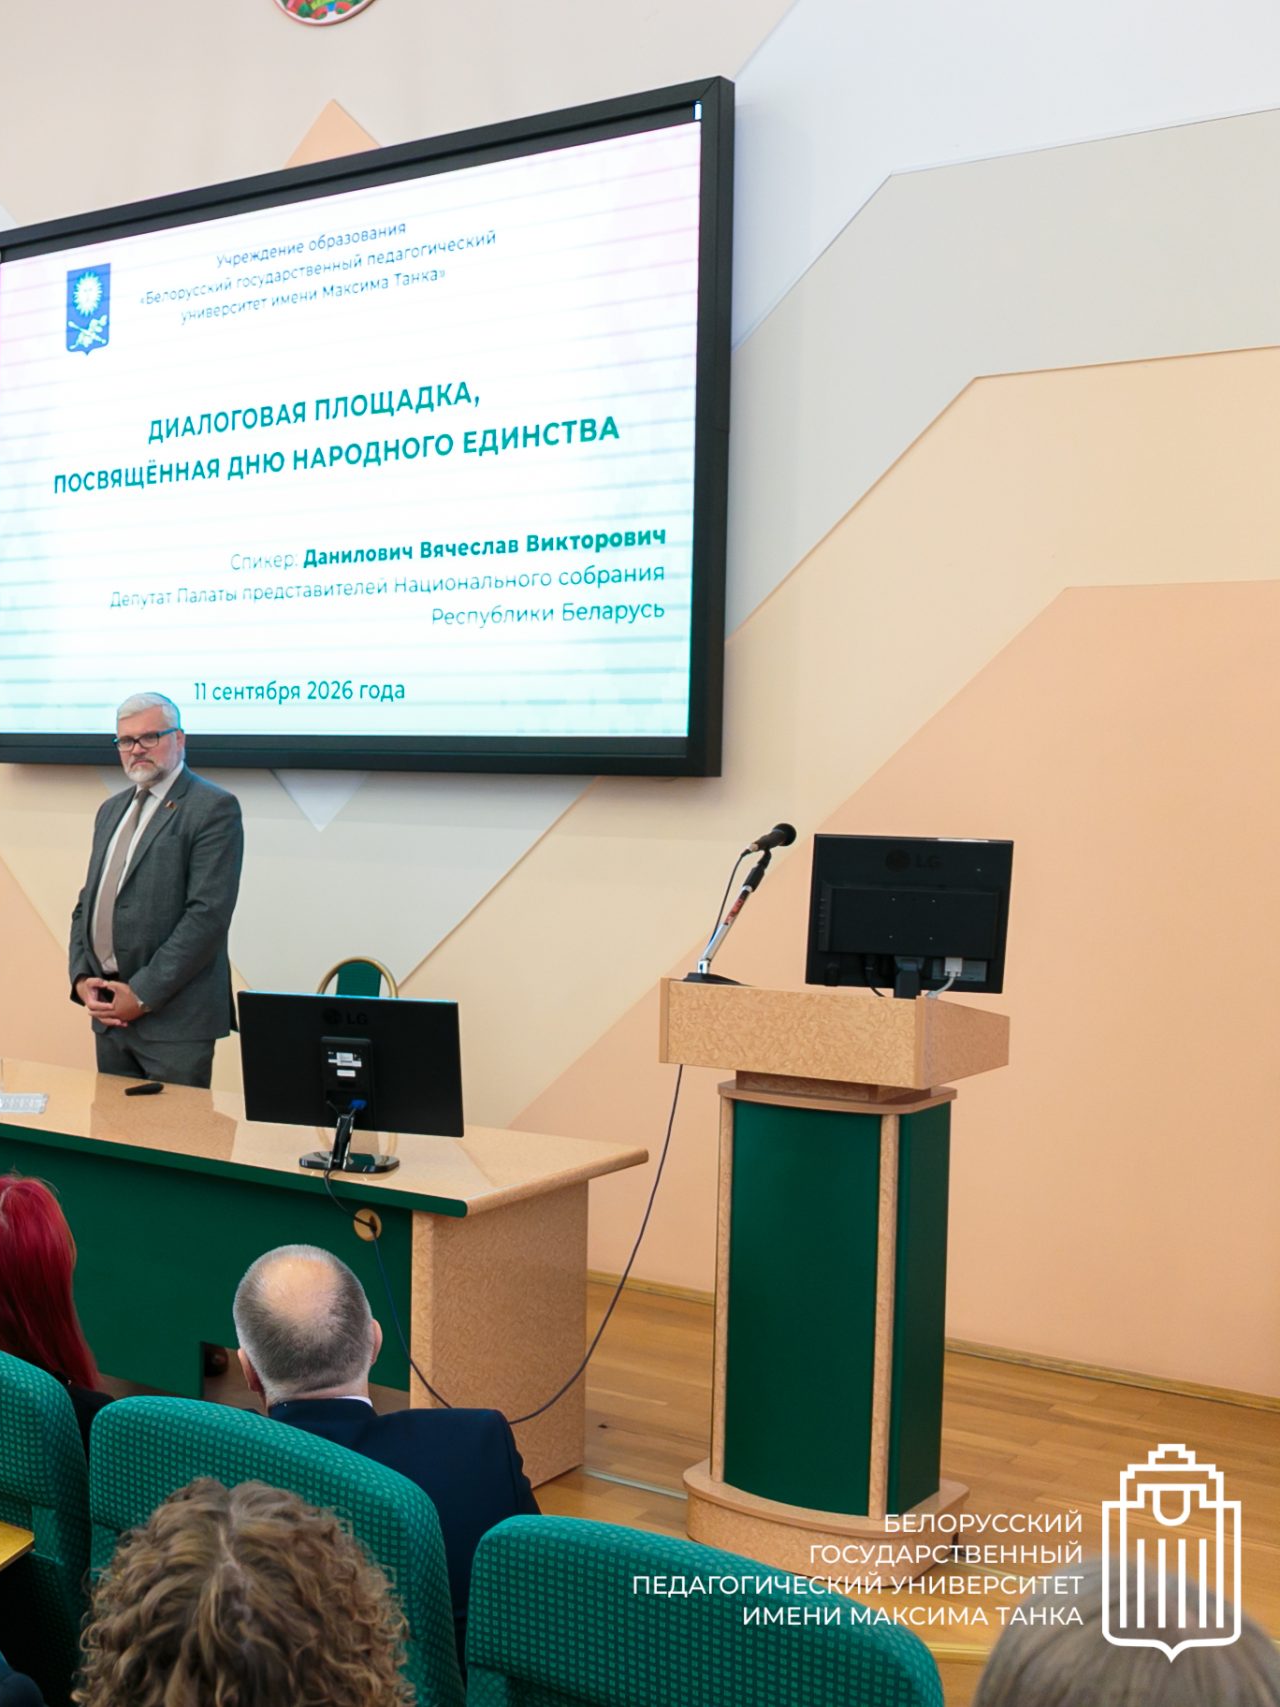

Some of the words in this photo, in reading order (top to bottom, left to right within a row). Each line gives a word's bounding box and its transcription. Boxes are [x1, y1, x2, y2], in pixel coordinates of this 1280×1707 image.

[140, 277, 232, 305] «Белорусский
[236, 254, 362, 289] государственный
[367, 230, 496, 266] педагогический
[216, 242, 304, 268] Учреждение
[308, 222, 407, 251] образования
[181, 297, 267, 326] университет
[271, 290, 317, 307] имени
[322, 276, 389, 299] Максима
[394, 268, 446, 287] Танка»
[148, 401, 306, 445] ДИАЛОГОВАЯ
[314, 381, 480, 421] ПЛОЩАДКА,
[54, 458, 220, 494] ПОСВЯЩЁННАЯ
[227, 451, 285, 481] ДНЮ
[293, 433, 454, 471] НАРОДНОГО
[463, 416, 620, 457] ЕДИНСТВА
[230, 552, 299, 571] Спикер:
[303, 545, 413, 569] Данилович
[420, 538, 519, 559] Вячеслав
[526, 528, 666, 553] Викторович
[110, 590, 172, 610] Депутат
[176, 587, 237, 604] Палаты
[242, 578, 387, 603] представителей
[394, 572, 552, 594] Национального
[558, 565, 665, 589] собрания
[431, 605, 554, 629] Республики
[562, 601, 665, 625] Беларусь
[194, 682, 206, 700] 11
[212, 680, 300, 705] сентября
[307, 680, 353, 700] 2026
[359, 682, 405, 702] года
[916, 853, 942, 869] LG
[346, 1012, 368, 1025] LG
